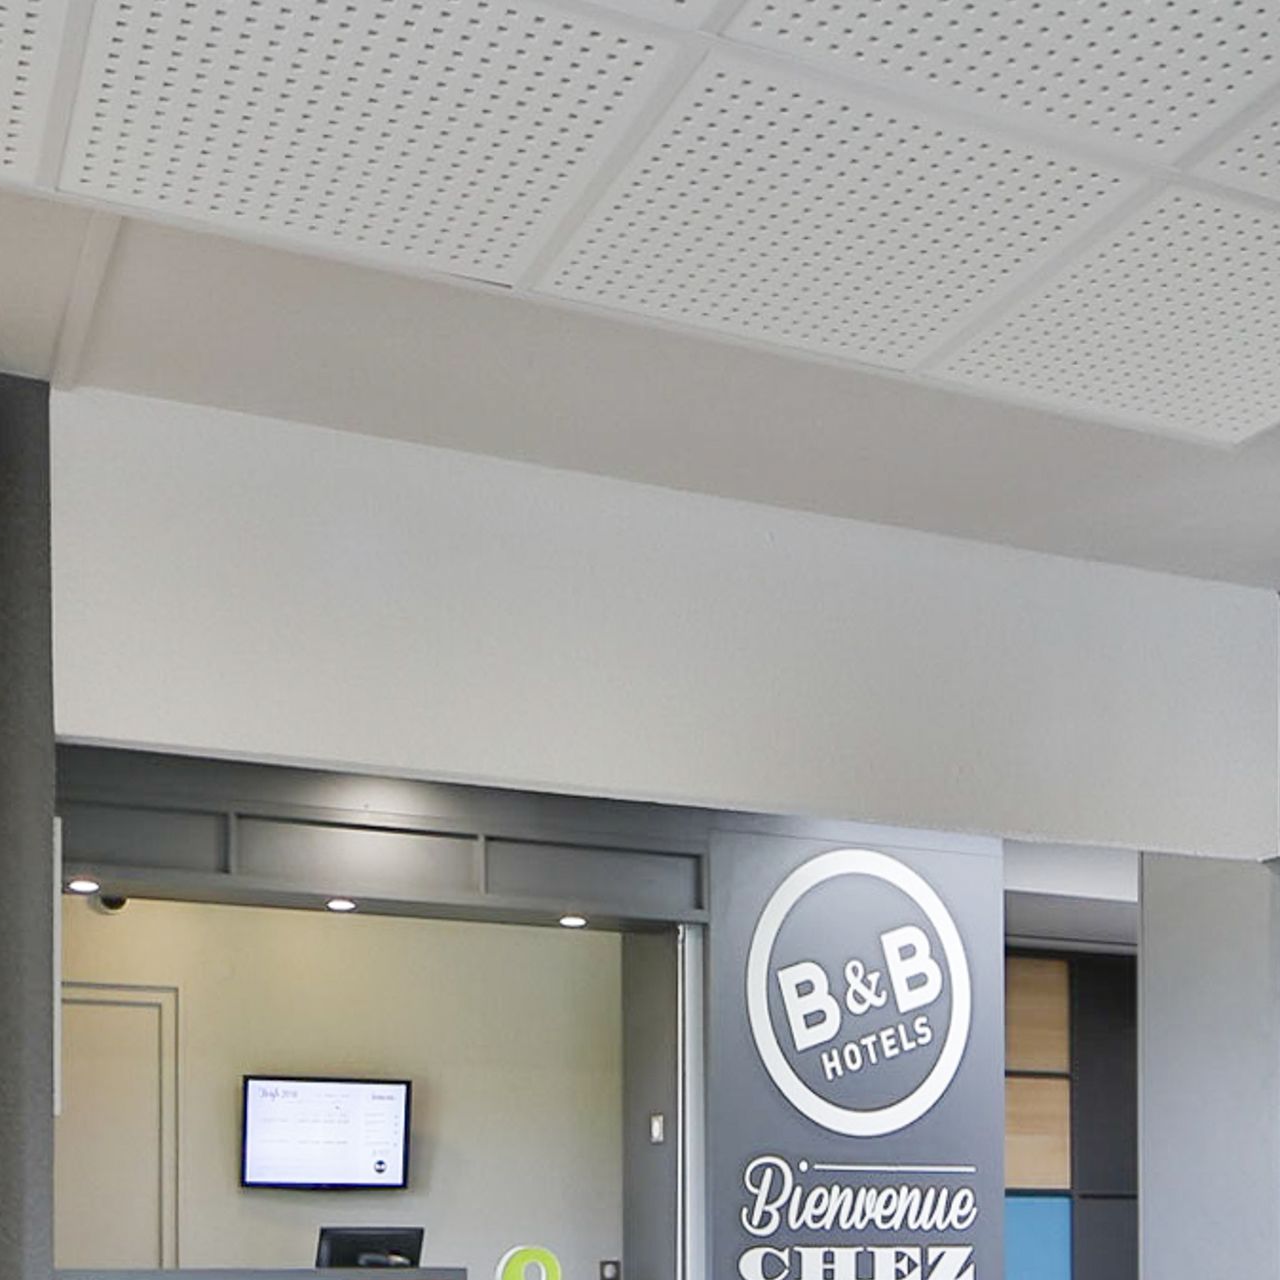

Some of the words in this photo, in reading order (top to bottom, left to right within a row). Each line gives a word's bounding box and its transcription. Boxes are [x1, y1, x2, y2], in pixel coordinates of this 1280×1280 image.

[777, 925, 943, 1051] B&B
[820, 1016, 933, 1081] HOTELS
[741, 1156, 977, 1237] Bienvenue
